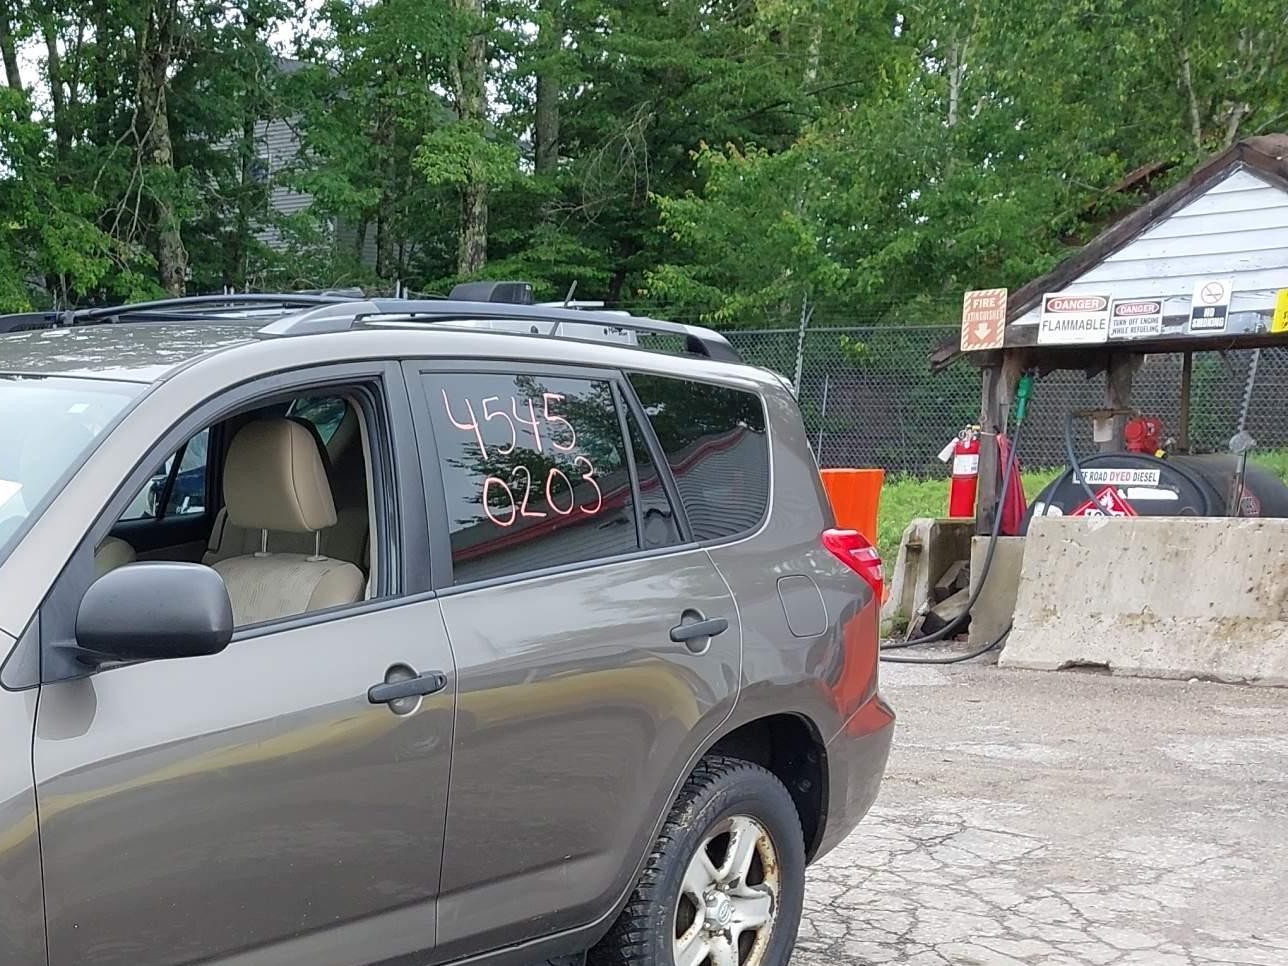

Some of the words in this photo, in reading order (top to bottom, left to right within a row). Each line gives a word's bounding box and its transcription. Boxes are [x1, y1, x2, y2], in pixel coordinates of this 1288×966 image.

[973, 297, 996, 308] FIRE
[1055, 300, 1099, 310] DANGER
[1120, 303, 1155, 313] DANGER
[1042, 319, 1106, 332] FLAMMABLE
[1128, 318, 1138, 326] OFF
[1191, 317, 1225, 328] SMOKING
[441, 388, 577, 461] 4545
[1089, 471, 1107, 481] ROAD
[1109, 472, 1131, 481] DYED
[1133, 472, 1157, 482] DIESEL
[482, 456, 602, 527] 0203
